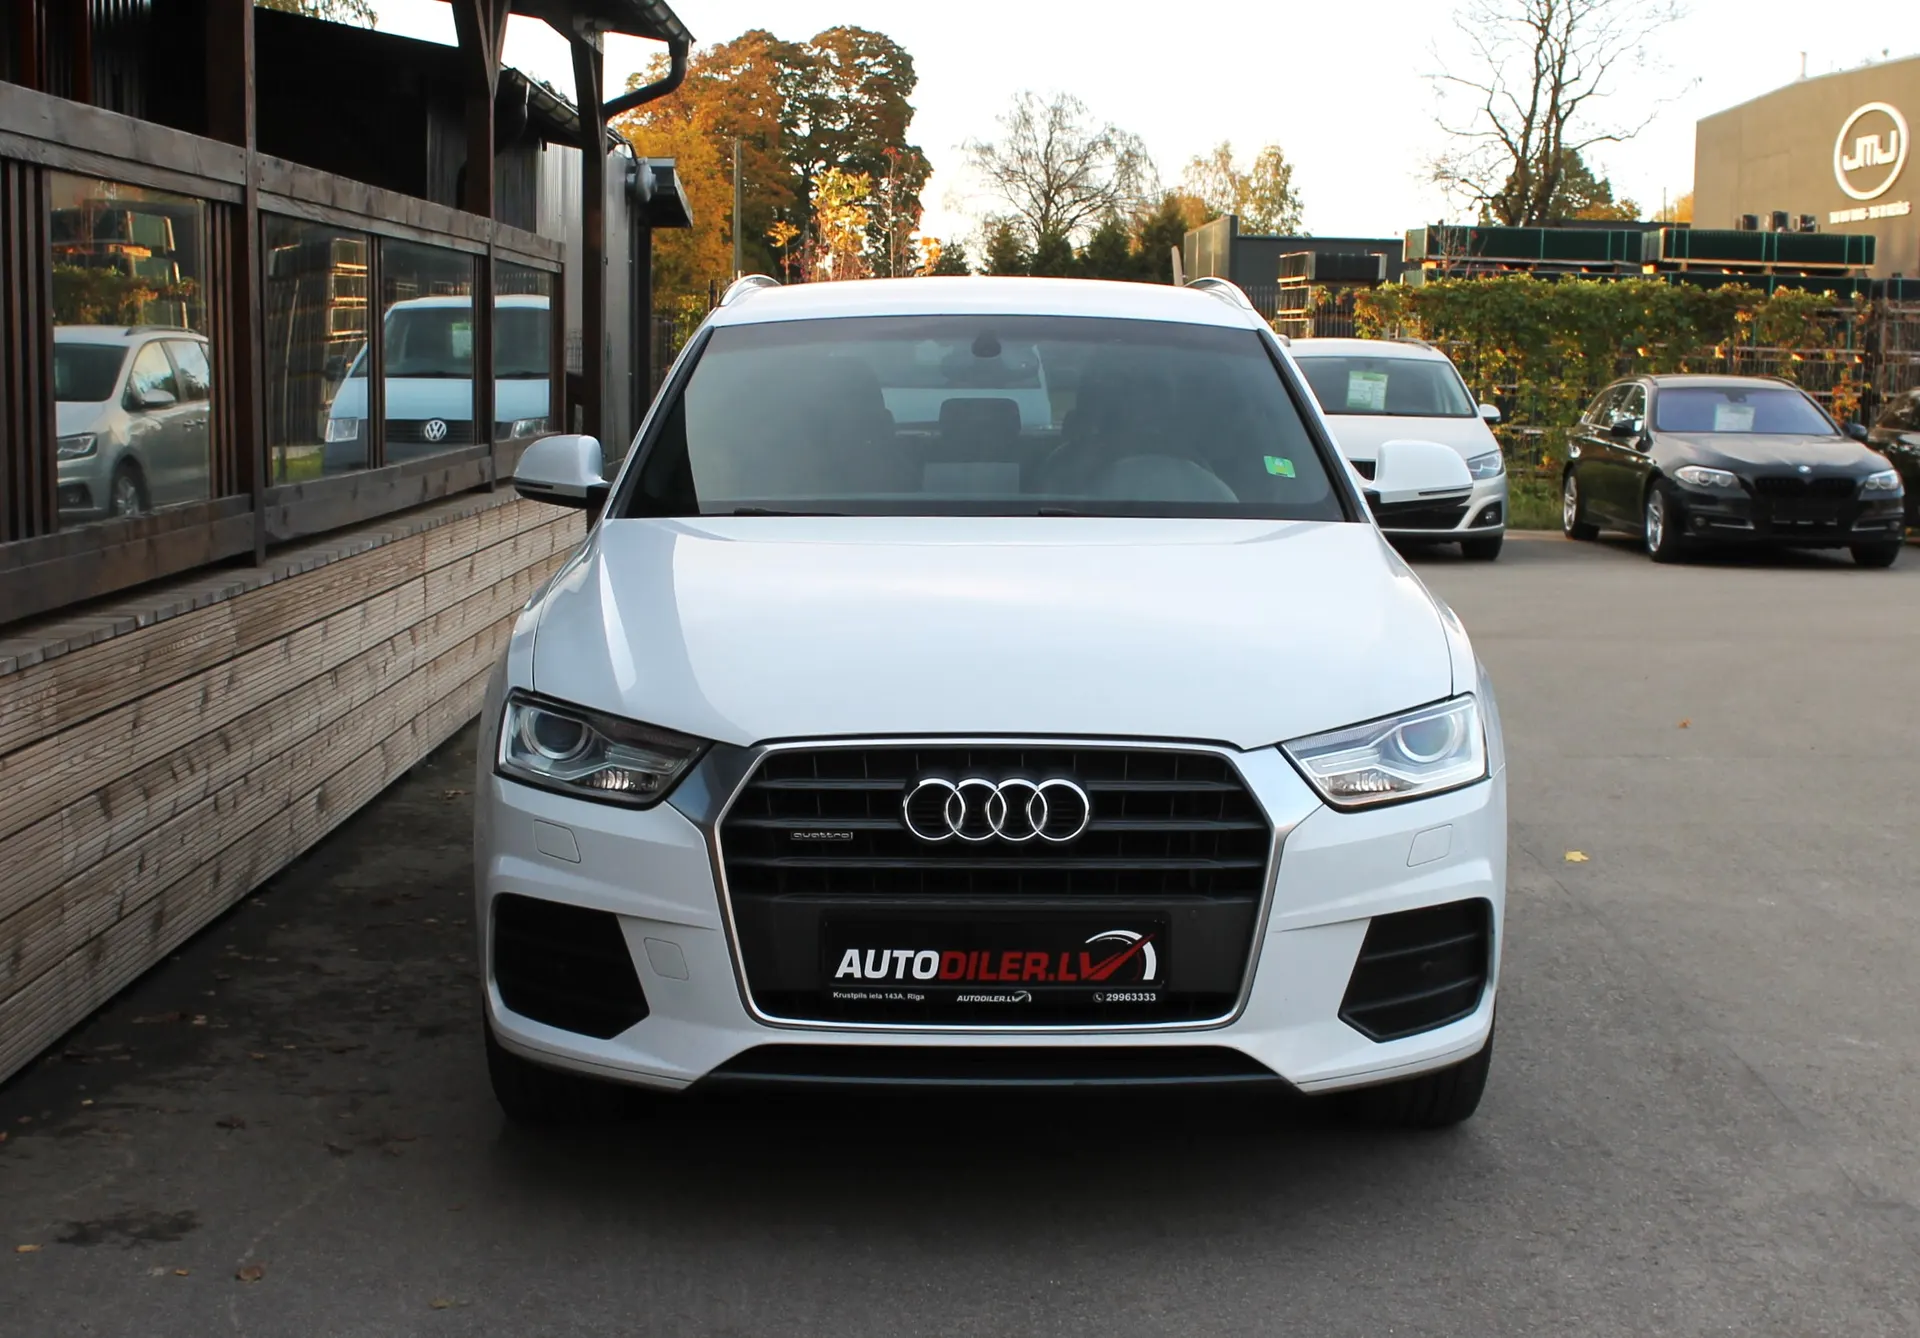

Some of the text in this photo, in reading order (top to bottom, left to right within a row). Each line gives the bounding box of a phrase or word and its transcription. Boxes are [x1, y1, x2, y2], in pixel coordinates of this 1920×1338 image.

[792, 831, 851, 839] quattro
[835, 945, 1132, 981] AUTODILER.LV
[833, 991, 868, 1000] Krustpils
[869, 992, 883, 1000] iela
[956, 993, 1024, 1002] AUTODILER.LV
[1106, 992, 1157, 1002] 29963333
